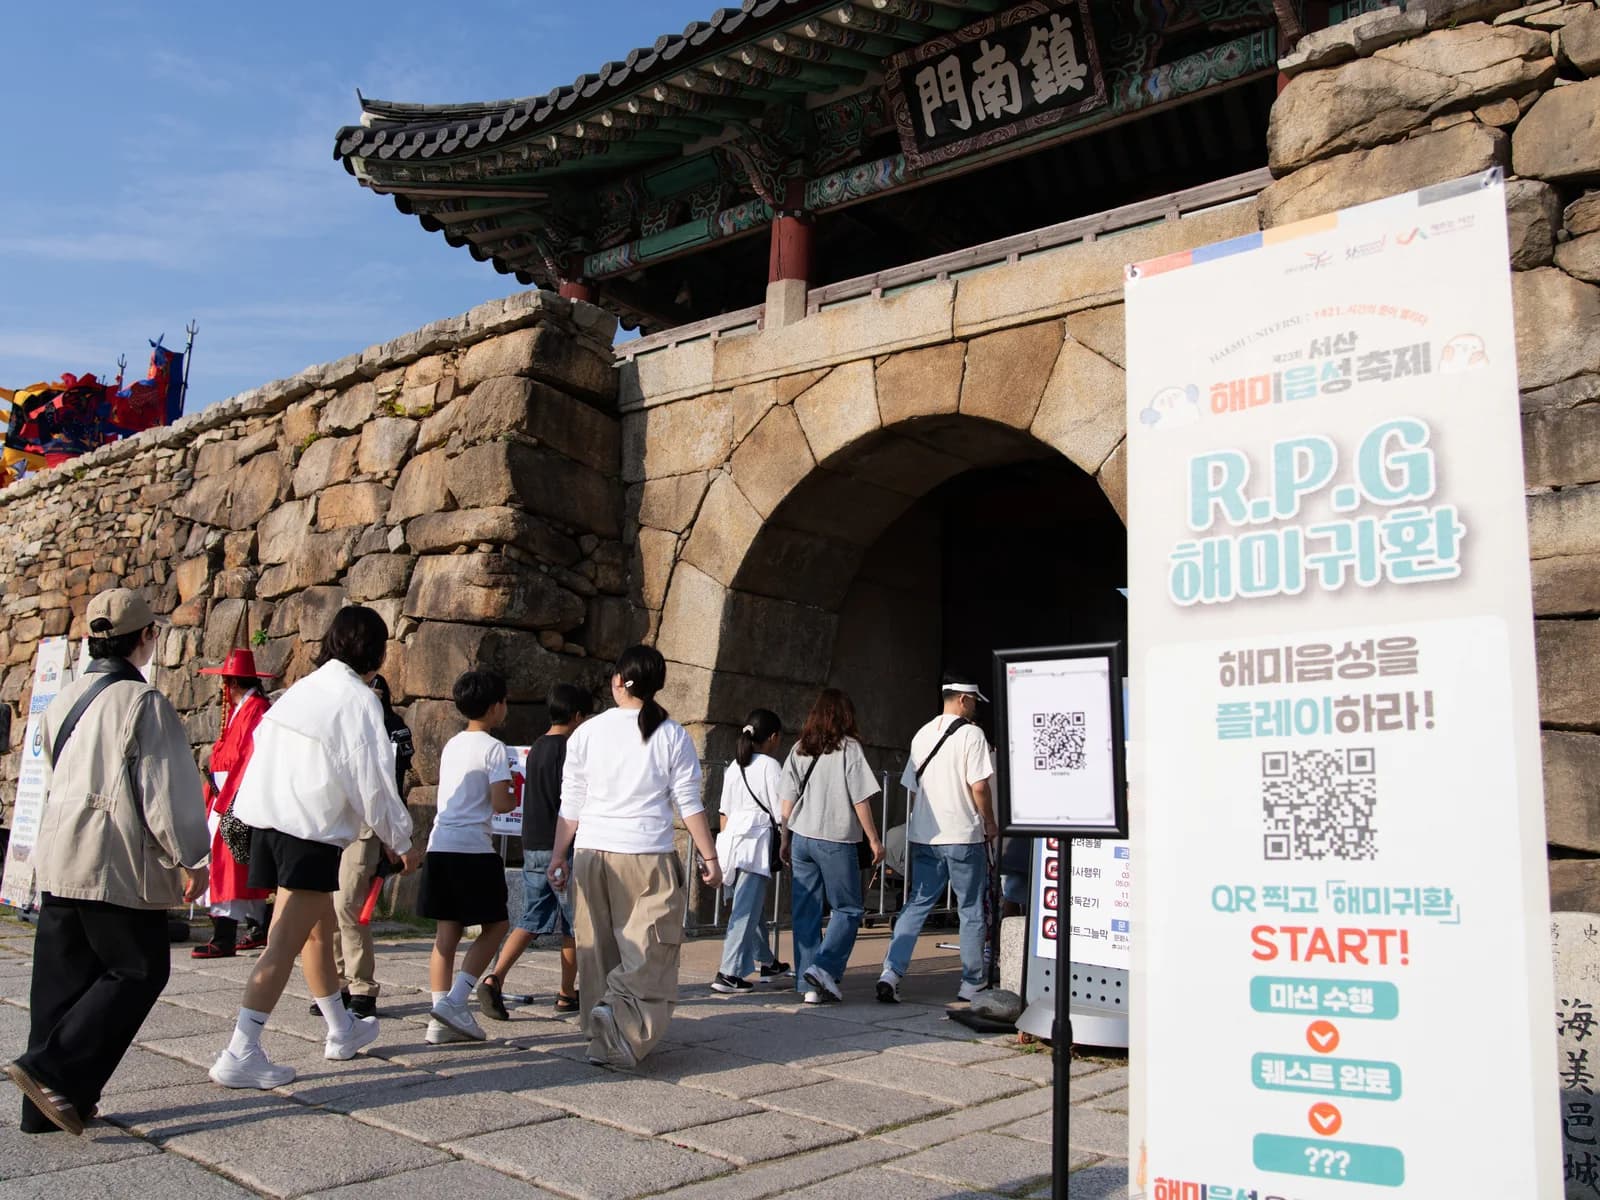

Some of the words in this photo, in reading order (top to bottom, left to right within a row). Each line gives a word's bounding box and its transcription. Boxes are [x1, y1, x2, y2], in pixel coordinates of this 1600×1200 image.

[1308, 331, 1359, 359] 서산
[1209, 341, 1433, 414] 해미읍성축제
[1189, 420, 1432, 530] R.P.G
[1170, 508, 1464, 602] 해미귀환
[1218, 636, 1419, 688] 해미읍성을
[1215, 690, 1435, 740] 플레이하라!
[1211, 885, 1256, 913] QR
[1261, 885, 1319, 914] 찍고
[1250, 926, 1410, 966] START!
[1269, 982, 1319, 1009] 미션
[1323, 986, 1374, 1013] 수행
[1260, 1059, 1335, 1089] 퀘스트
[1340, 1066, 1392, 1095] 완료
[1305, 1147, 1351, 1176] ???
